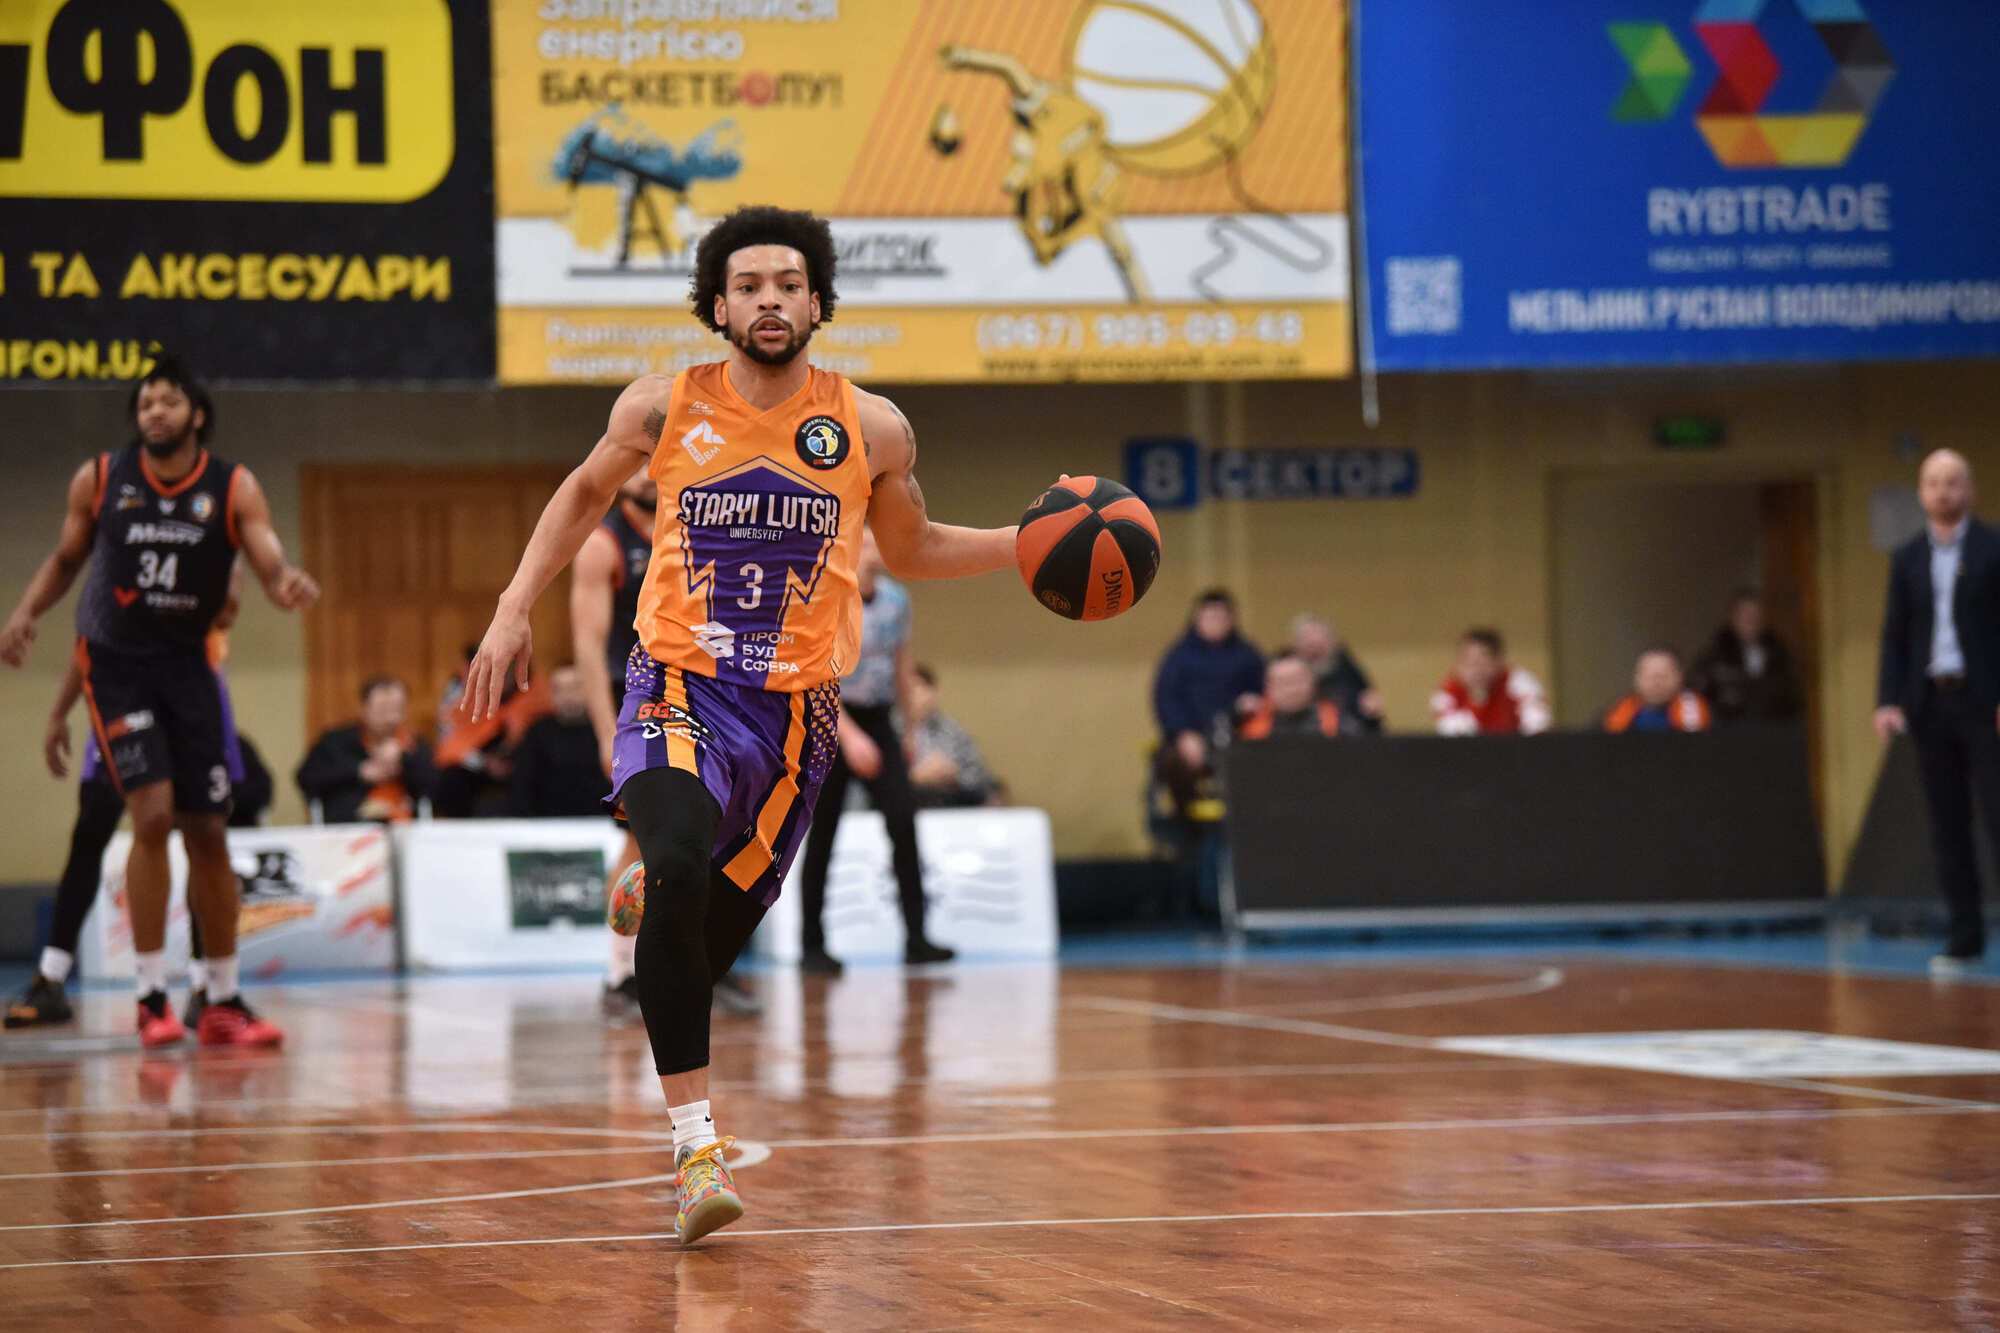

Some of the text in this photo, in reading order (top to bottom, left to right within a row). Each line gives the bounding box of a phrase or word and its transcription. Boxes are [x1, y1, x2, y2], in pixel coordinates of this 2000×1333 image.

[1649, 184, 1890, 234] RYBTRADE
[30, 252, 100, 298] ТА
[120, 253, 452, 301] АКСЕСУАРИ
[1776, 281, 2000, 330] ВОЛОДИМИРОВ
[977, 313, 1083, 352] (067)
[680, 490, 838, 537] STARYI LUTSK
[729, 527, 784, 542] UNIVERSYTET
[137, 549, 179, 592] 34
[736, 562, 764, 610] 3
[742, 644, 777, 659] БУД
[743, 631, 795, 645] ПРОМ
[742, 658, 800, 673] СФЕРА
[208, 764, 231, 803] 3
